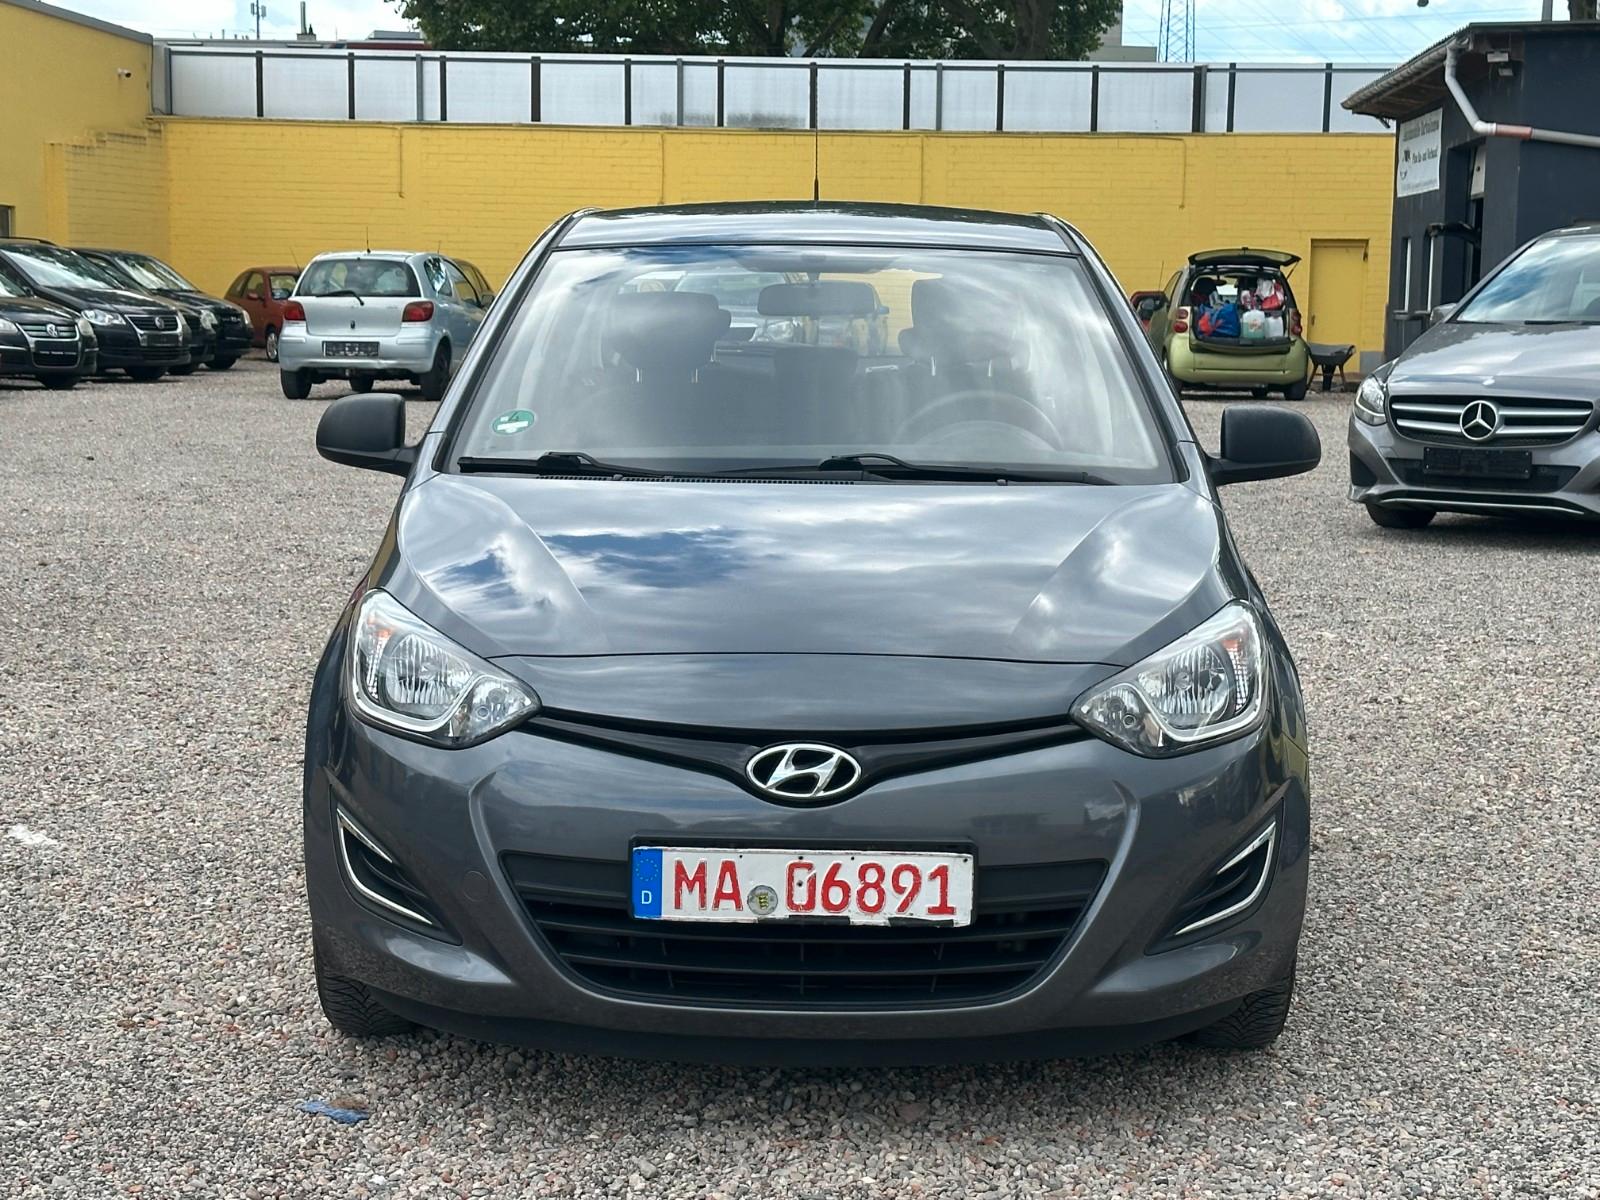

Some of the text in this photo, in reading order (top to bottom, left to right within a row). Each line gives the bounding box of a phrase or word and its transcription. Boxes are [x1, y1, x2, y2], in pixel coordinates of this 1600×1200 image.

[641, 890, 652, 905] D
[674, 859, 957, 915] MA 06891
